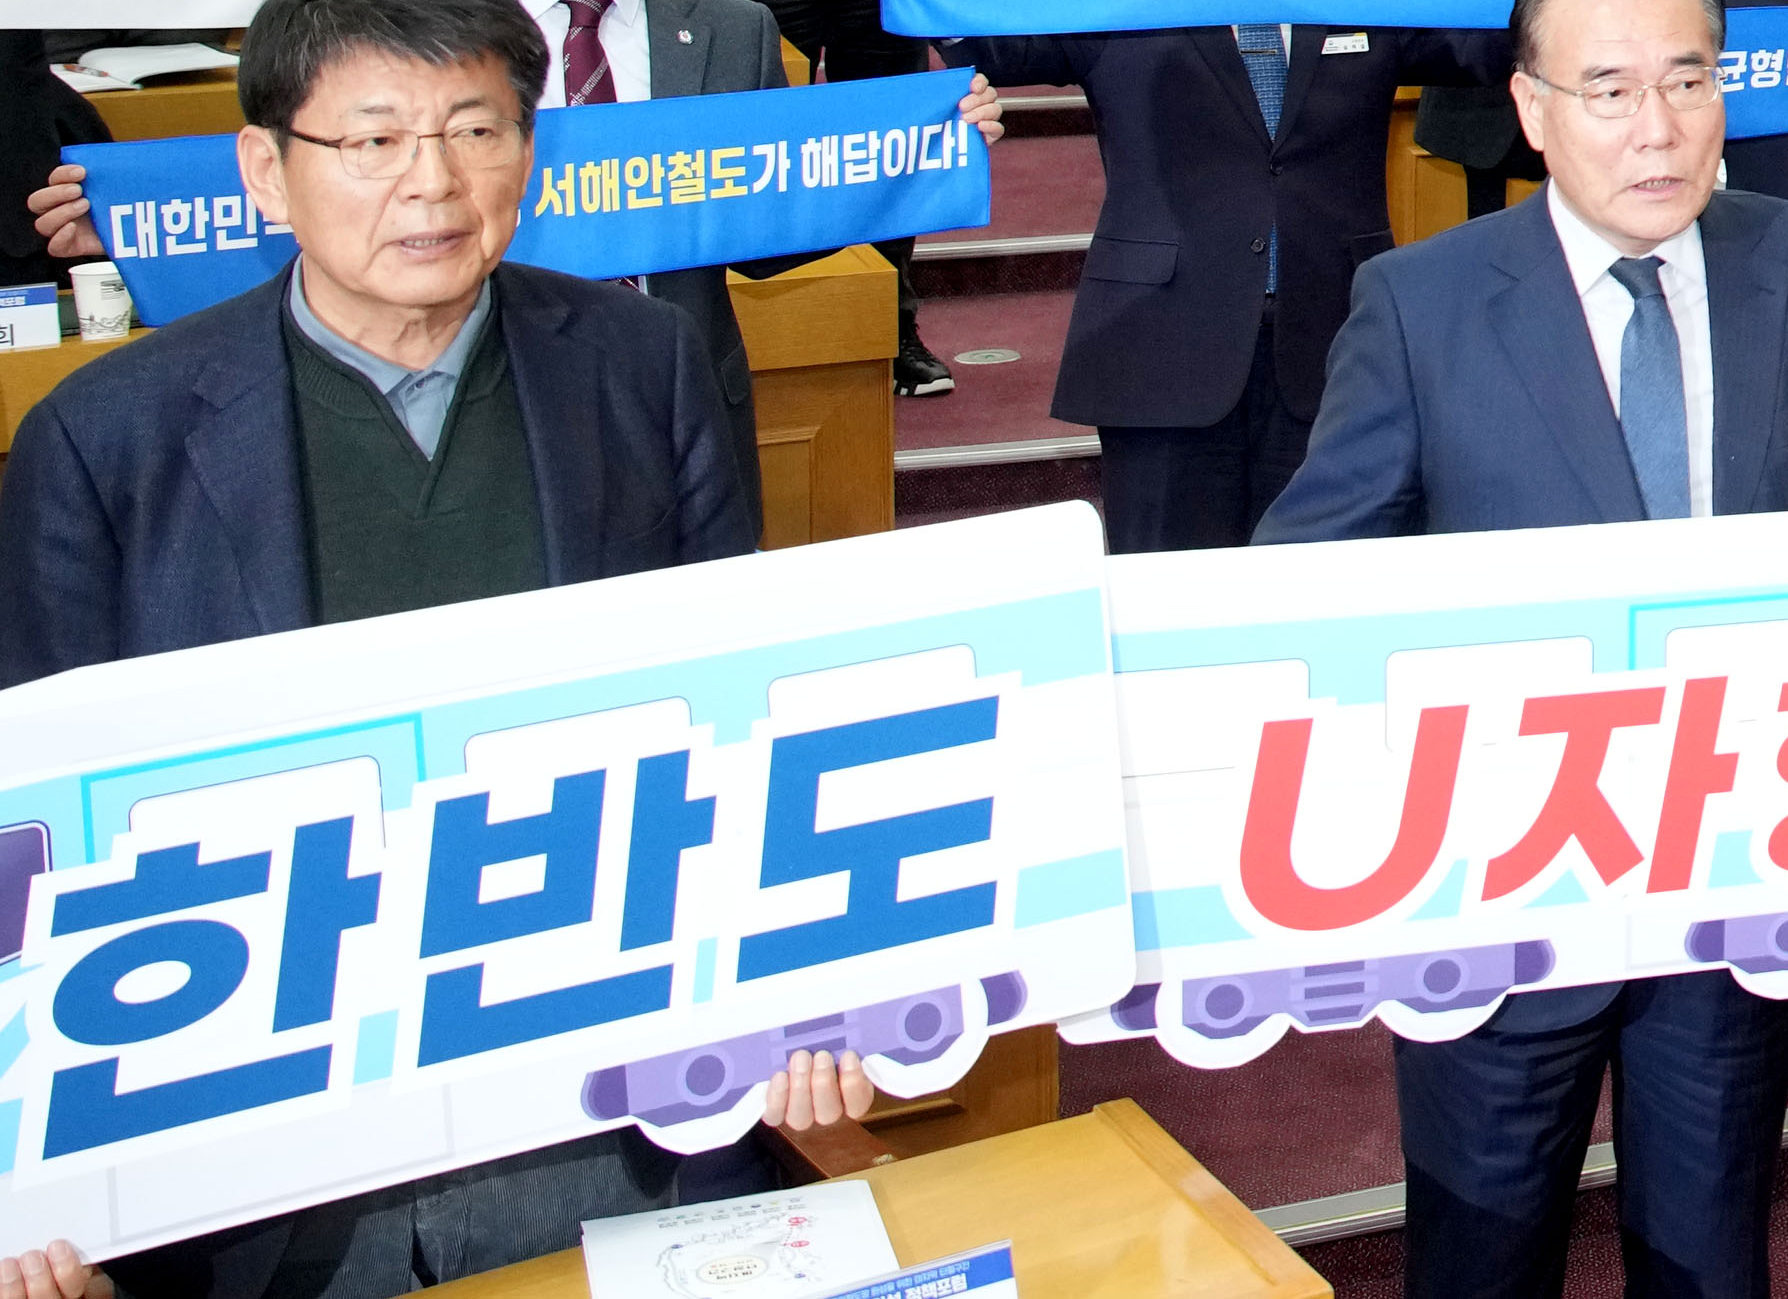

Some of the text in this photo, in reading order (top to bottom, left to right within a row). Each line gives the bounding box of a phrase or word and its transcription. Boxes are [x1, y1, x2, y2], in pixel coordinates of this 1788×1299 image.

[537, 139, 793, 217] 서해안철도가
[801, 120, 969, 188] 해답이다!
[44, 696, 1001, 1159] 한반도
